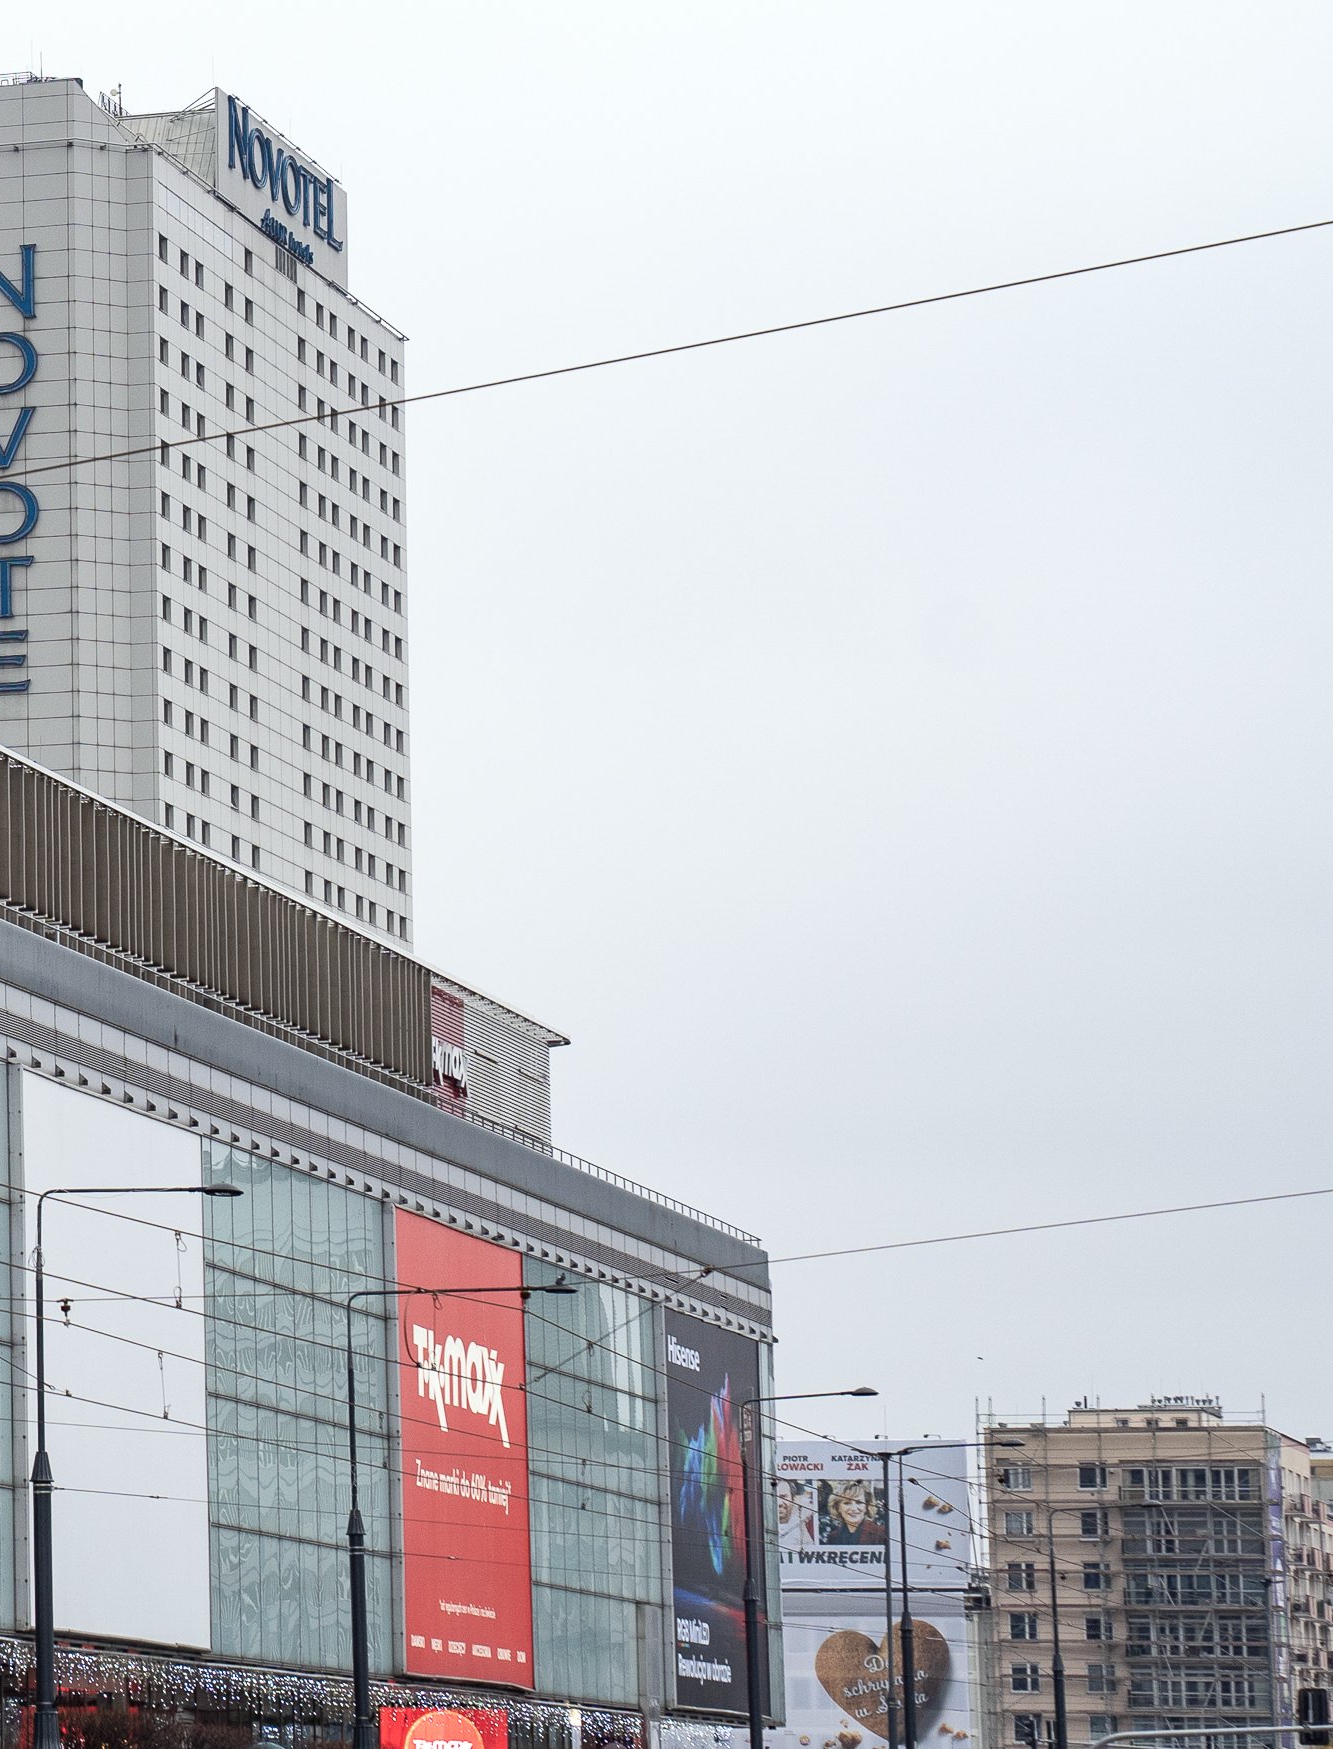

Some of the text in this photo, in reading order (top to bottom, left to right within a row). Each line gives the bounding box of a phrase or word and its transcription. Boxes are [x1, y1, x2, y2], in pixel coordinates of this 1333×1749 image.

[227, 94, 343, 253] NOVOTEL
[667, 1335, 700, 1372] Hisense
[783, 1455, 808, 1463] PIOTR
[847, 1461, 869, 1472] ŻAK
[415, 1459, 439, 1491] Znane
[439, 1468, 459, 1496] marki
[460, 1470, 470, 1499] do
[471, 1473, 487, 1503] 60%
[677, 1653, 706, 1686] Rewolucja
